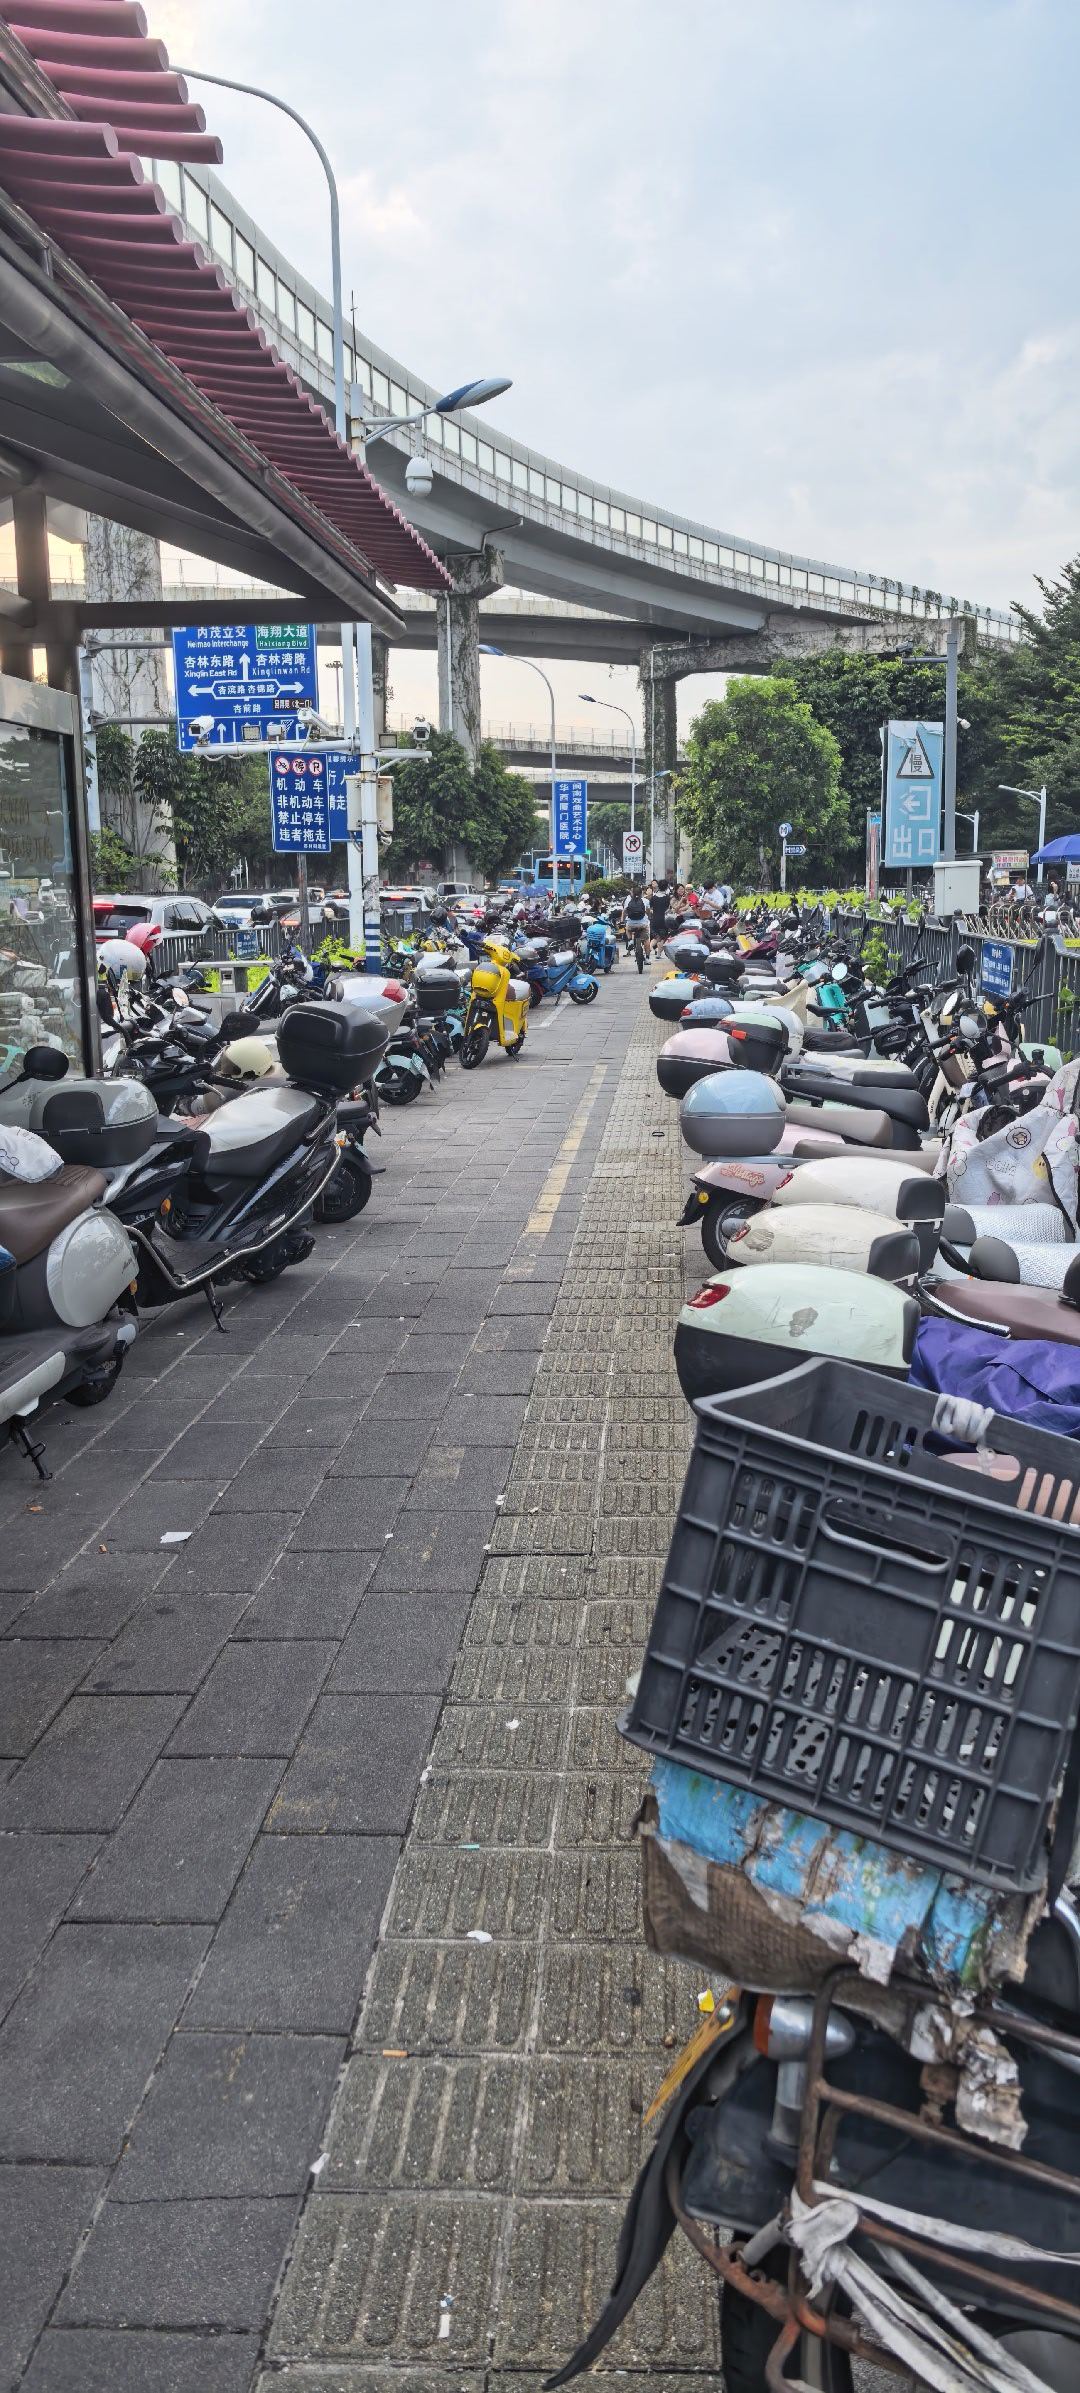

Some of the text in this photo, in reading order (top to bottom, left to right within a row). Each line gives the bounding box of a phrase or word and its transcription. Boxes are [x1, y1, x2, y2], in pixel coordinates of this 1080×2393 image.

[197, 626, 246, 639] 内茂立交
[258, 625, 308, 638] 海翔大道
[184, 655, 234, 669] 杏林东路
[256, 653, 306, 666] 杏林湾路
[184, 670, 208, 679] Xinglin
[252, 666, 310, 677] Xinglinwan Rd
[218, 685, 245, 695] 杏滨路
[233, 703, 261, 714] 杏前路
[909, 753, 923, 773] 慢
[276, 777, 324, 793] 机动车
[277, 794, 324, 810] 非机动车
[559, 783, 569, 840] 华西厦门医院
[572, 782, 582, 840] 闽南戏曲艺术中心
[278, 811, 325, 826] 禁止停车
[279, 828, 327, 843] 违者拖走
[892, 824, 936, 859] 出口
